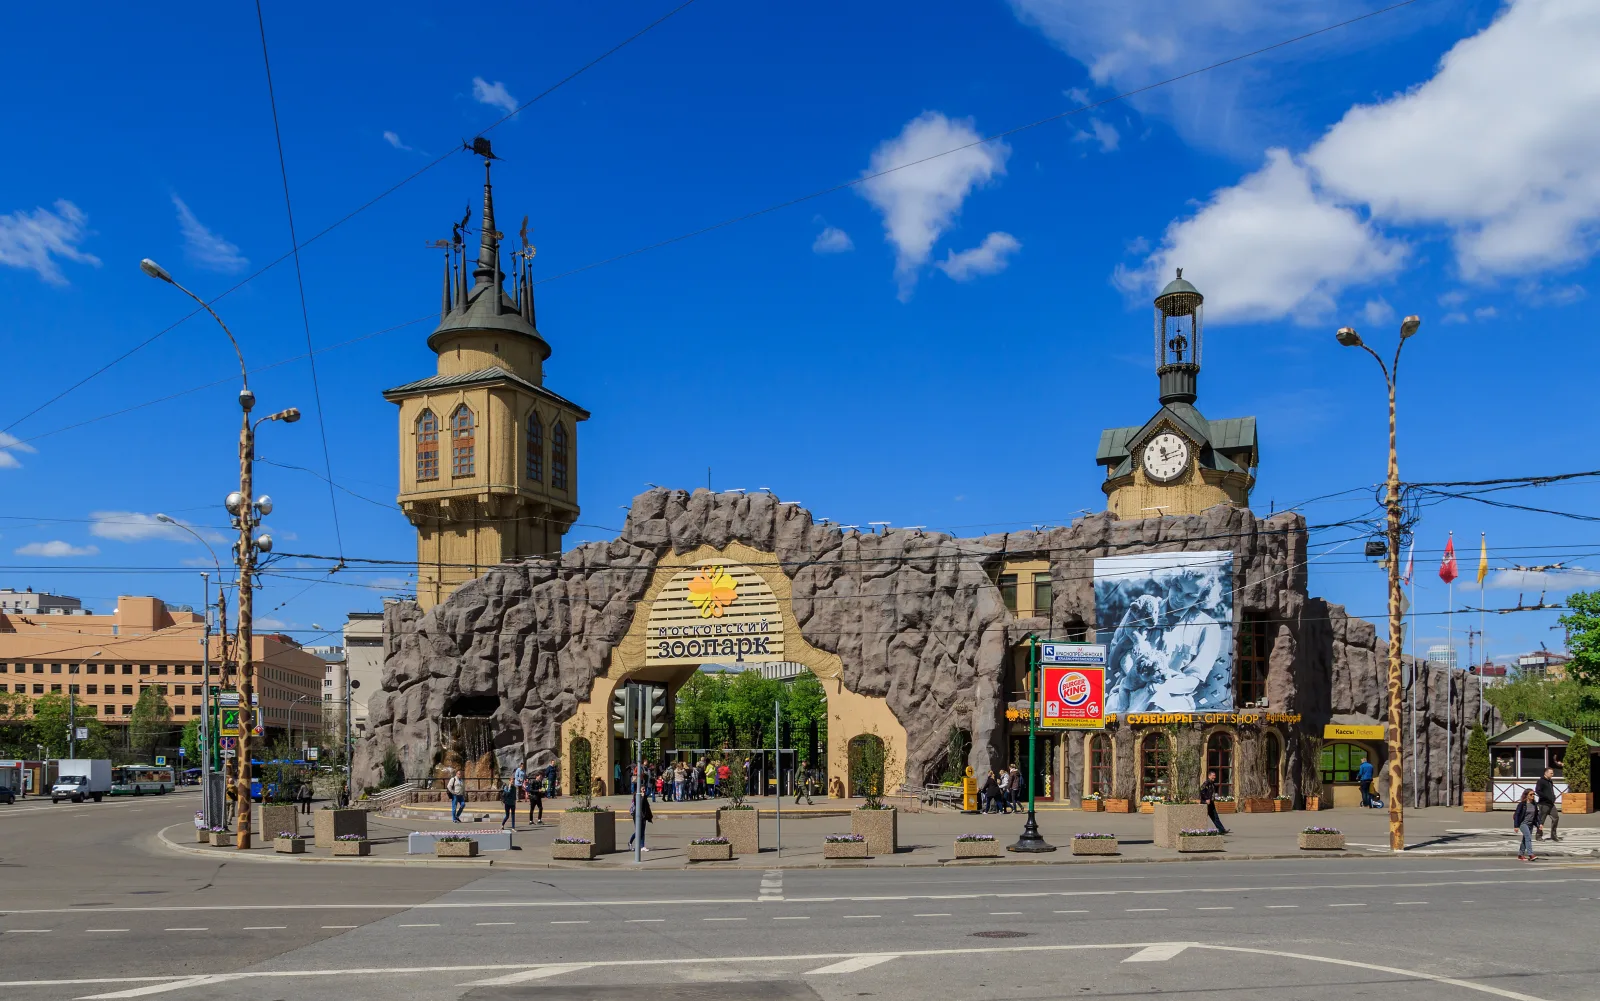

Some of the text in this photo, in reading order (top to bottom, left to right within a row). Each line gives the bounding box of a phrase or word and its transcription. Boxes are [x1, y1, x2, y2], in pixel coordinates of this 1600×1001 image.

[659, 619, 769, 636] МОСКОВСКИЙ
[658, 637, 770, 662] зоопарк
[1062, 679, 1085, 690] BURGER
[1063, 685, 1087, 698] KING
[1089, 705, 1099, 714] 24
[1127, 714, 1193, 724] СУВЕНИРЫ
[1204, 713, 1259, 724] GIFT SHOP
[1265, 712, 1302, 723] #giftshop#
